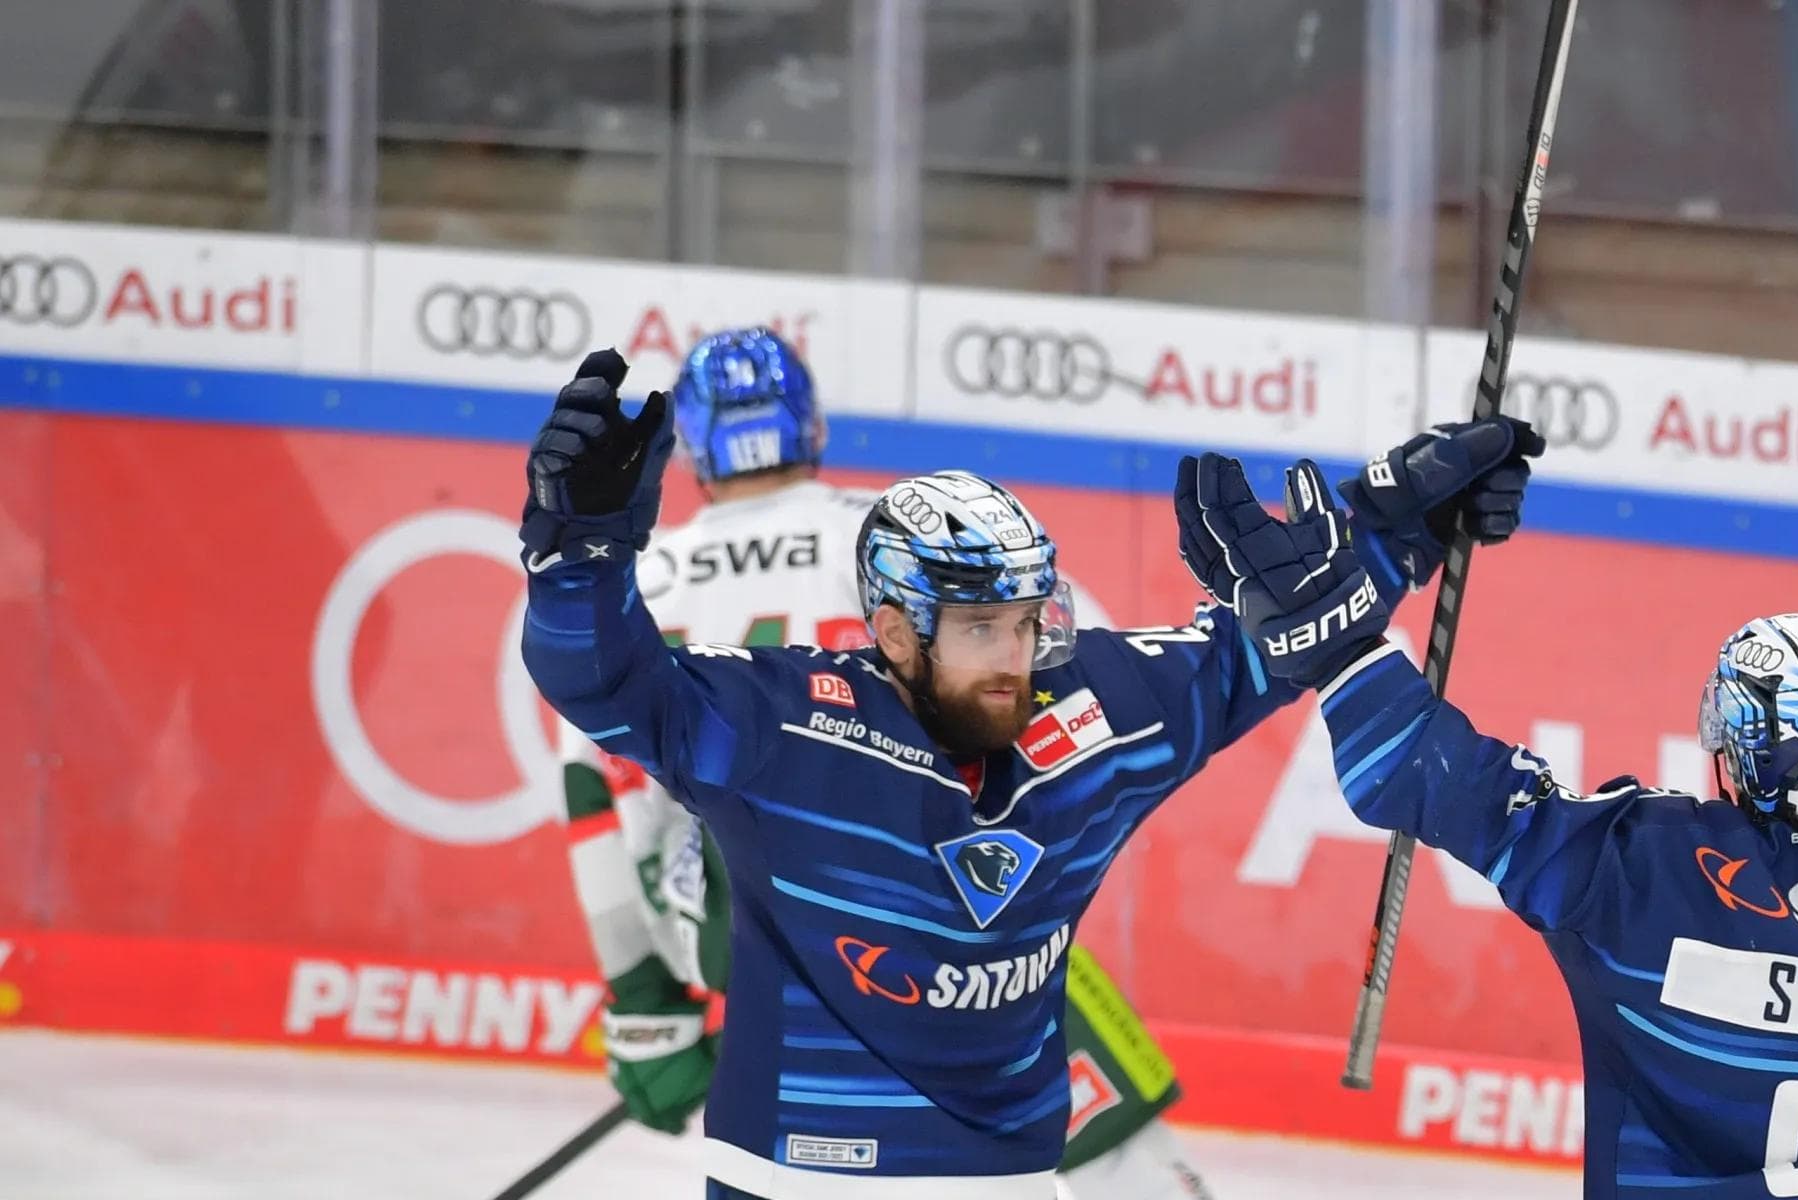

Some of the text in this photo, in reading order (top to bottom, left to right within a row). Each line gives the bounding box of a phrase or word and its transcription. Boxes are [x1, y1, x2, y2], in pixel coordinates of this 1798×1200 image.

[105, 269, 298, 334] Audi
[1144, 345, 1317, 416] Audi
[686, 531, 822, 584] swa
[809, 711, 935, 768] Regio Bayern
